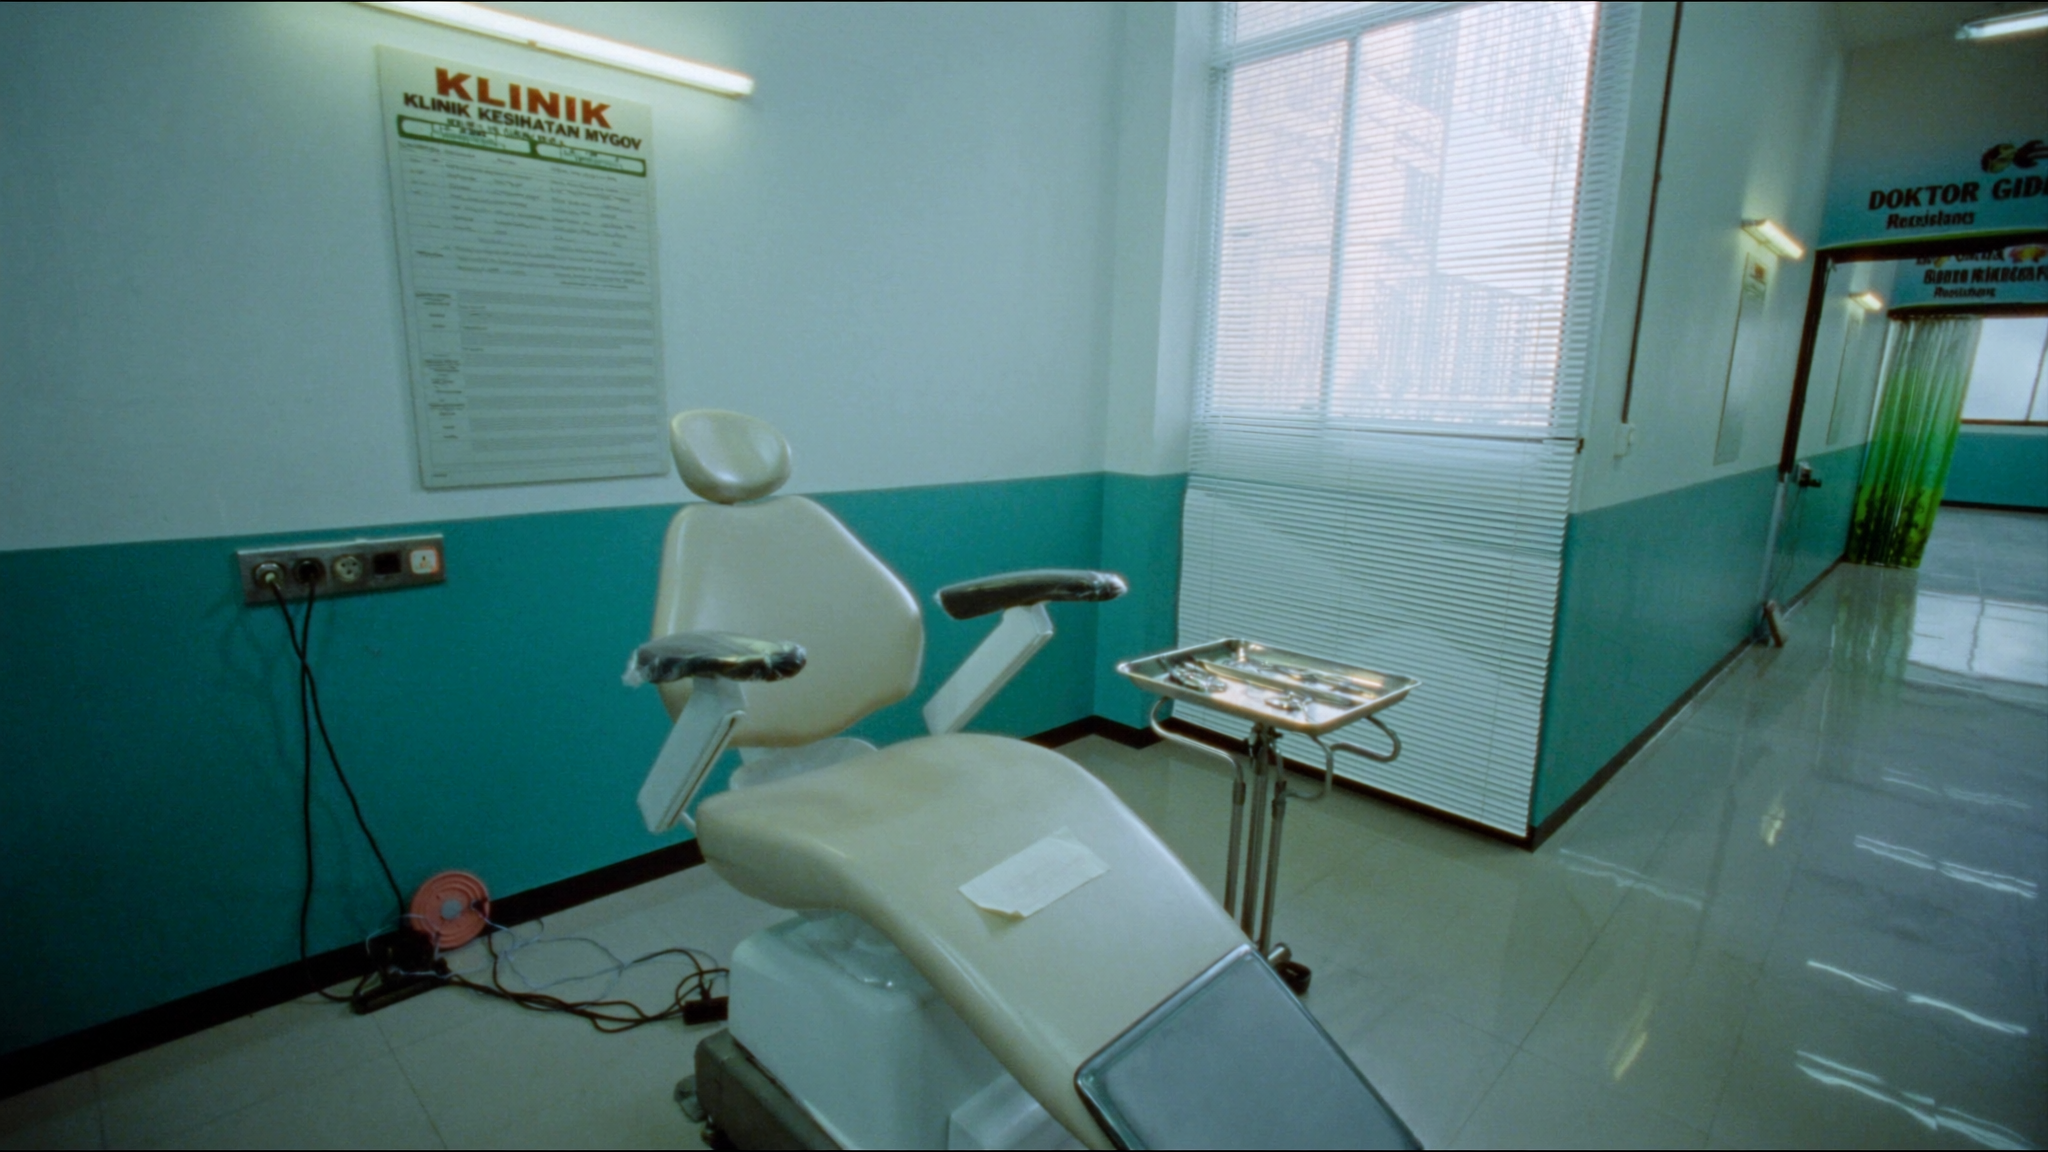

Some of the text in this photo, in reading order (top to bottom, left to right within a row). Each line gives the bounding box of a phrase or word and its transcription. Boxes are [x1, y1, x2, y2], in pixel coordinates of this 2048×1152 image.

[403, 92, 472, 119] KLINIK
[477, 106, 580, 139] KESIHATAN
[585, 127, 643, 150] MYGOV
[435, 67, 613, 129] KLINIK
[1868, 181, 1980, 211] DOKTOR
